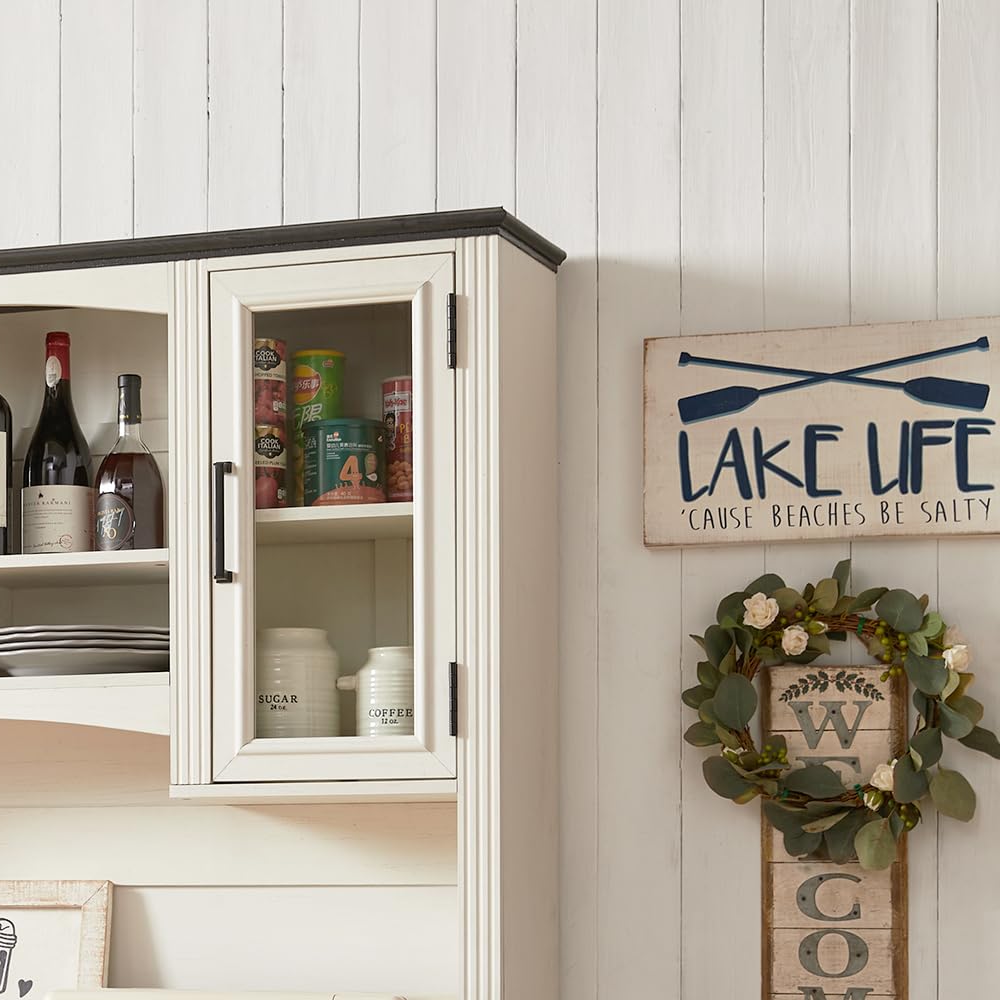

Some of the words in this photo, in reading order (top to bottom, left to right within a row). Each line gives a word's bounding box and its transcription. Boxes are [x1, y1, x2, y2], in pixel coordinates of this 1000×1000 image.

[339, 455, 363, 488] 4
[678, 424, 844, 502] LAKE
[867, 417, 996, 496] LIFE
[680, 506, 753, 531] 'CAUSE
[772, 502, 866, 527] BEACHES
[880, 500, 904, 525] BE
[920, 498, 991, 524] SALTY
[258, 694, 298, 704] SUGAR
[368, 708, 414, 718] COFFEE
